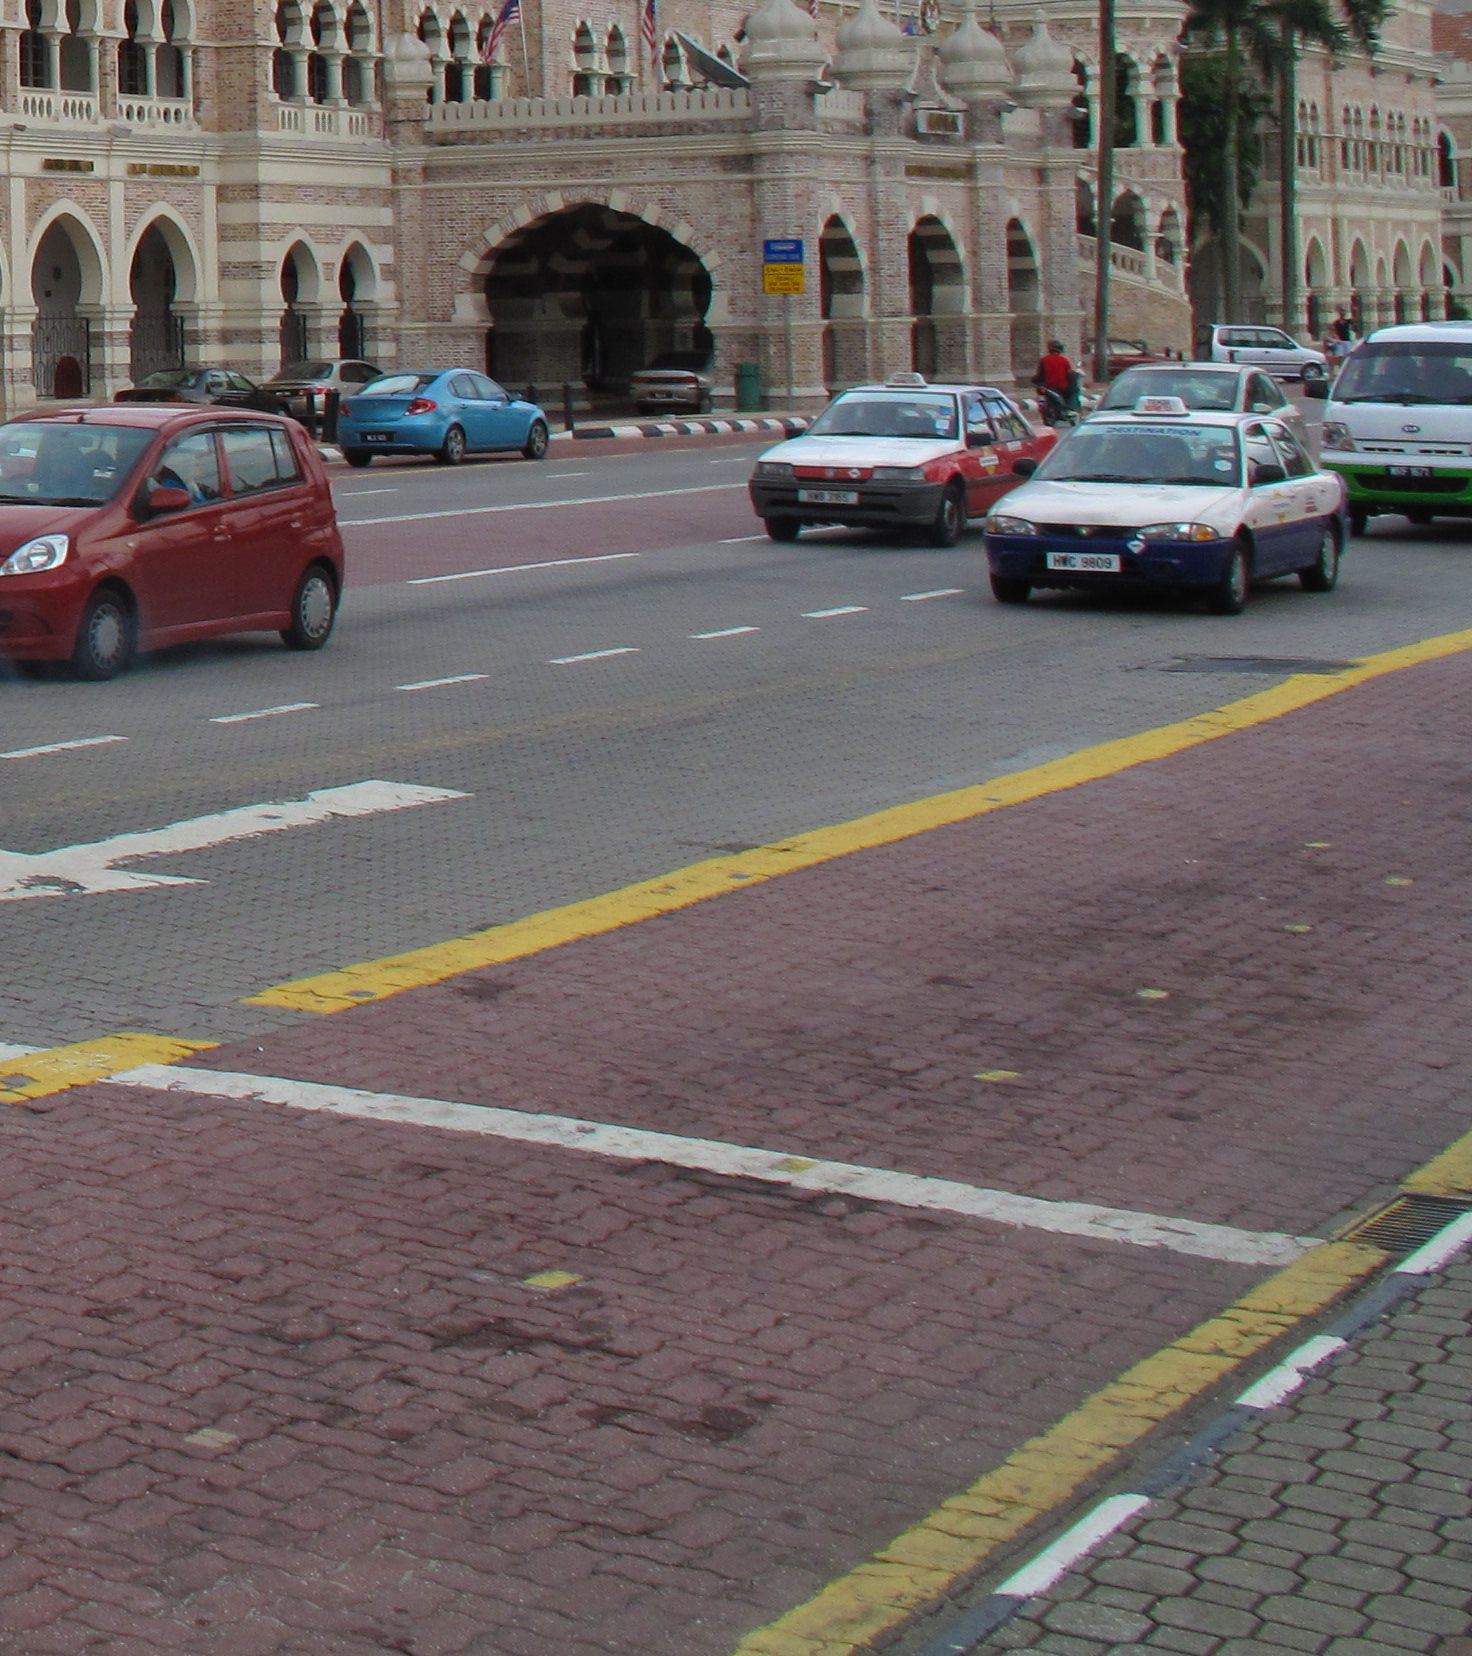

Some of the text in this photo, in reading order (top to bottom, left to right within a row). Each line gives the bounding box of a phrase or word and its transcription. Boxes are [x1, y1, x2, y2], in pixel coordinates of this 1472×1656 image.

[1105, 426, 1202, 437] DESTINATION
[1052, 554, 1113, 570] HWC 9809
